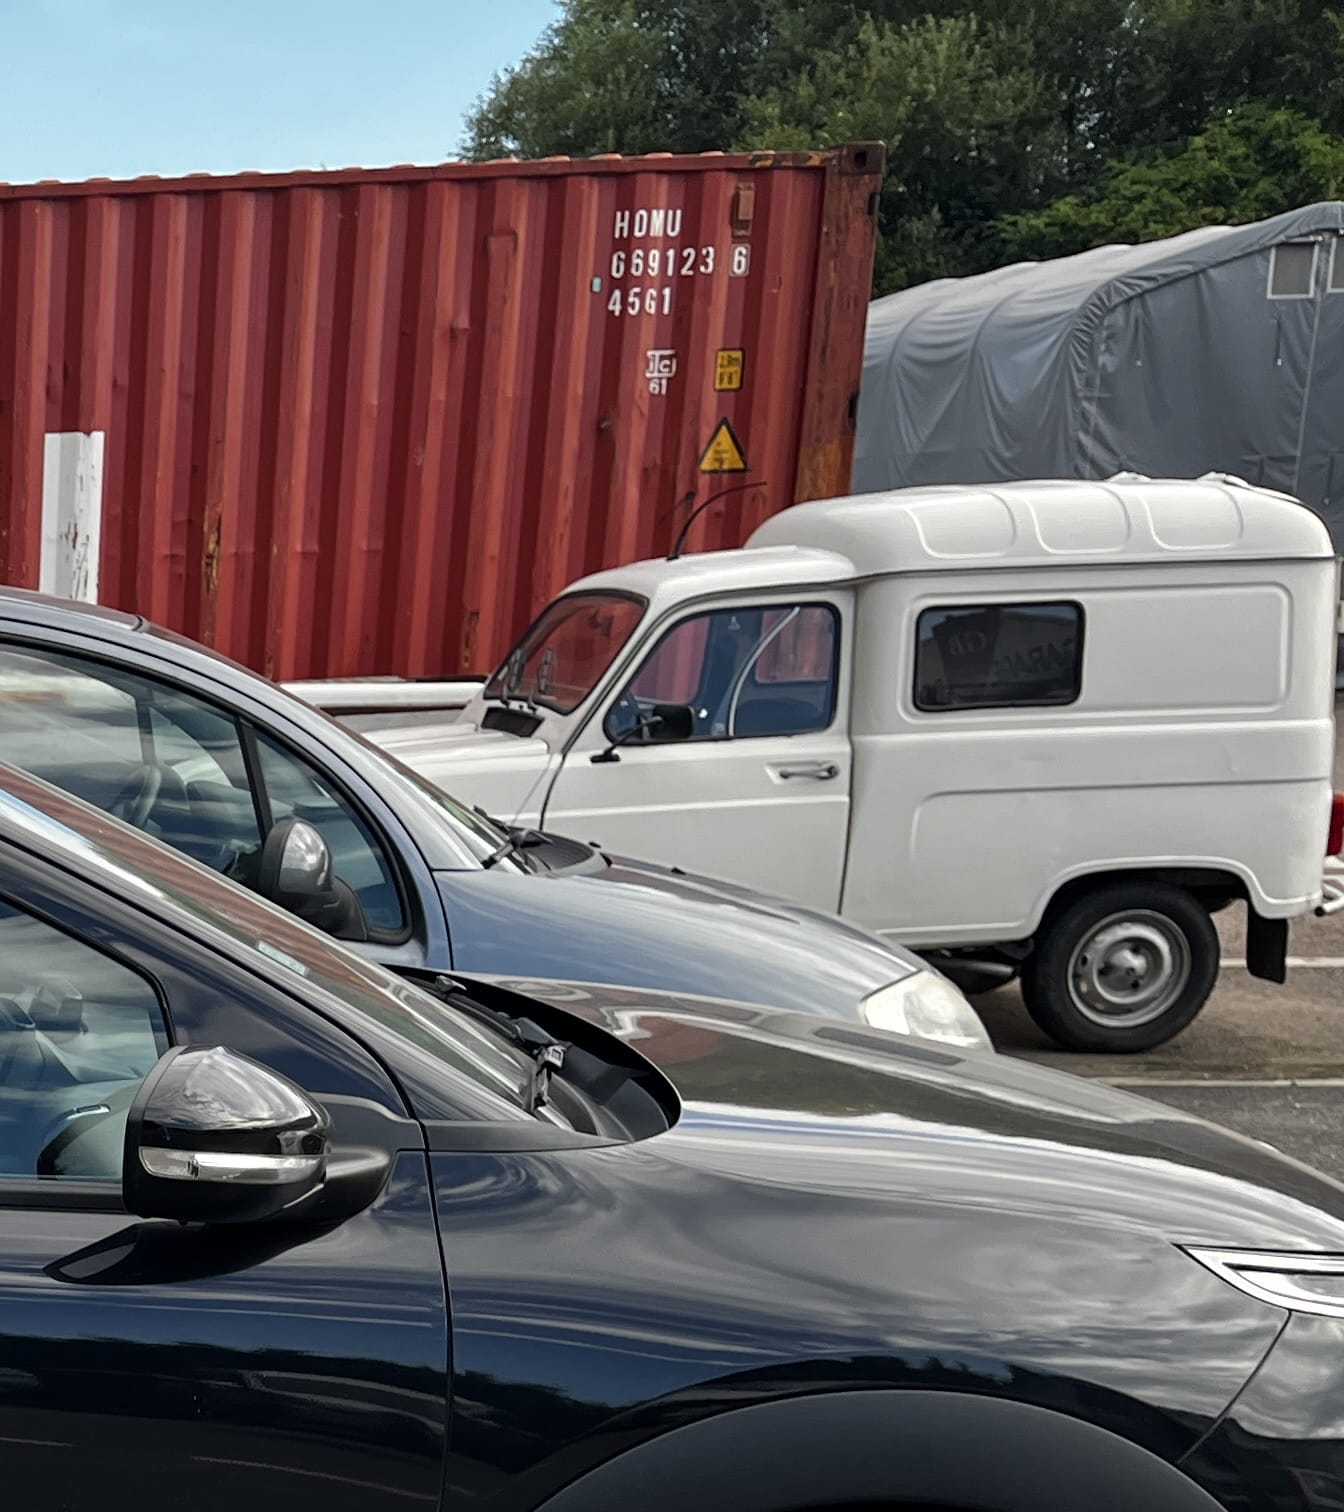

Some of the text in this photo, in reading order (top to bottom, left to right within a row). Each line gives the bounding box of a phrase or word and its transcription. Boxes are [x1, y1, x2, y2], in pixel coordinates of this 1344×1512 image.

[614, 209, 682, 238] HOMU
[611, 246, 747, 279] 669123 6
[608, 287, 672, 316] 45G1
[649, 378, 668, 396] 61
